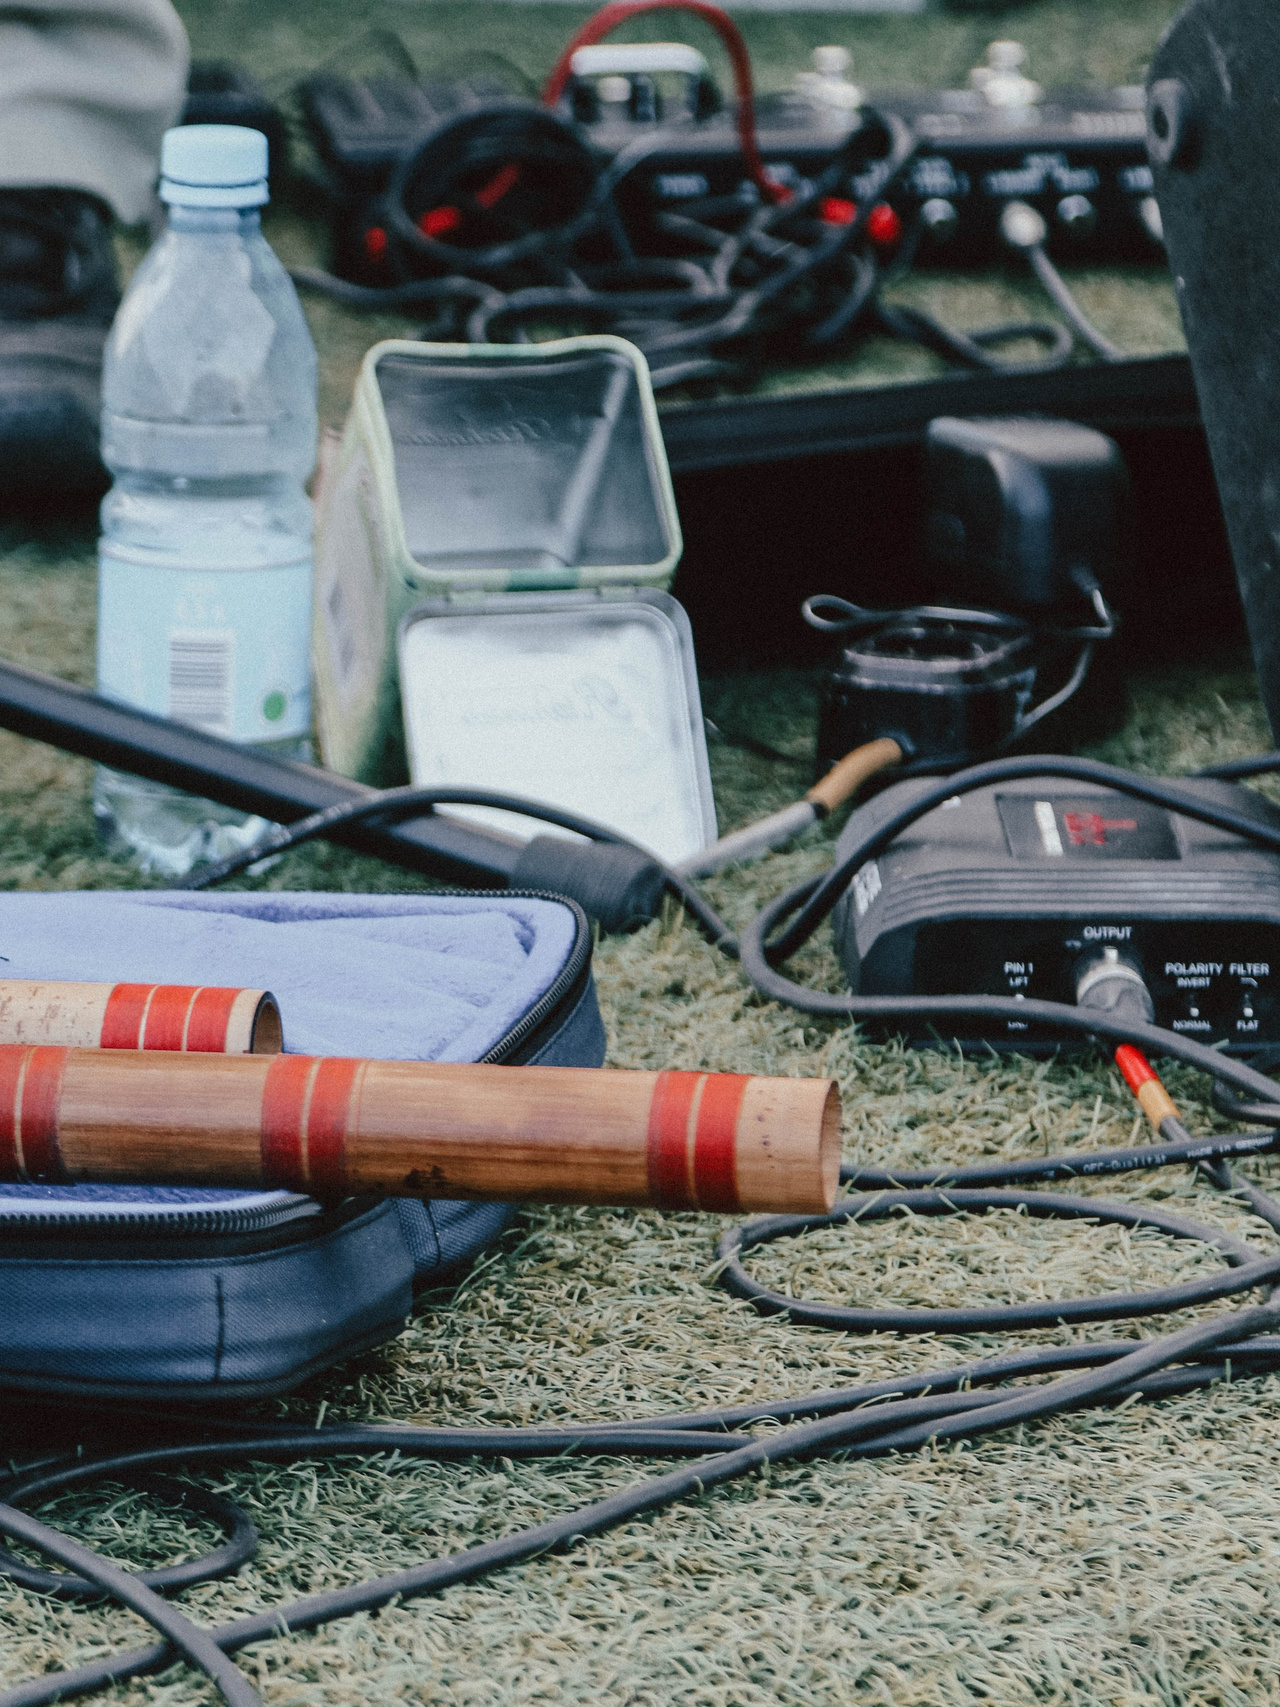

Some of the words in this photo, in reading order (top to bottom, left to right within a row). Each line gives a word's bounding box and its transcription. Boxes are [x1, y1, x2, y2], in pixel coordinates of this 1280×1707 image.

[1083, 926, 1132, 939] OUTPUT
[1004, 962, 1024, 974] PIN
[1165, 962, 1223, 975] POLARITY
[1229, 962, 1269, 975] FILTER
[1009, 976, 1028, 987] LIFT
[1177, 976, 1210, 988] INVERT
[1236, 1019, 1258, 1031] FLAT
